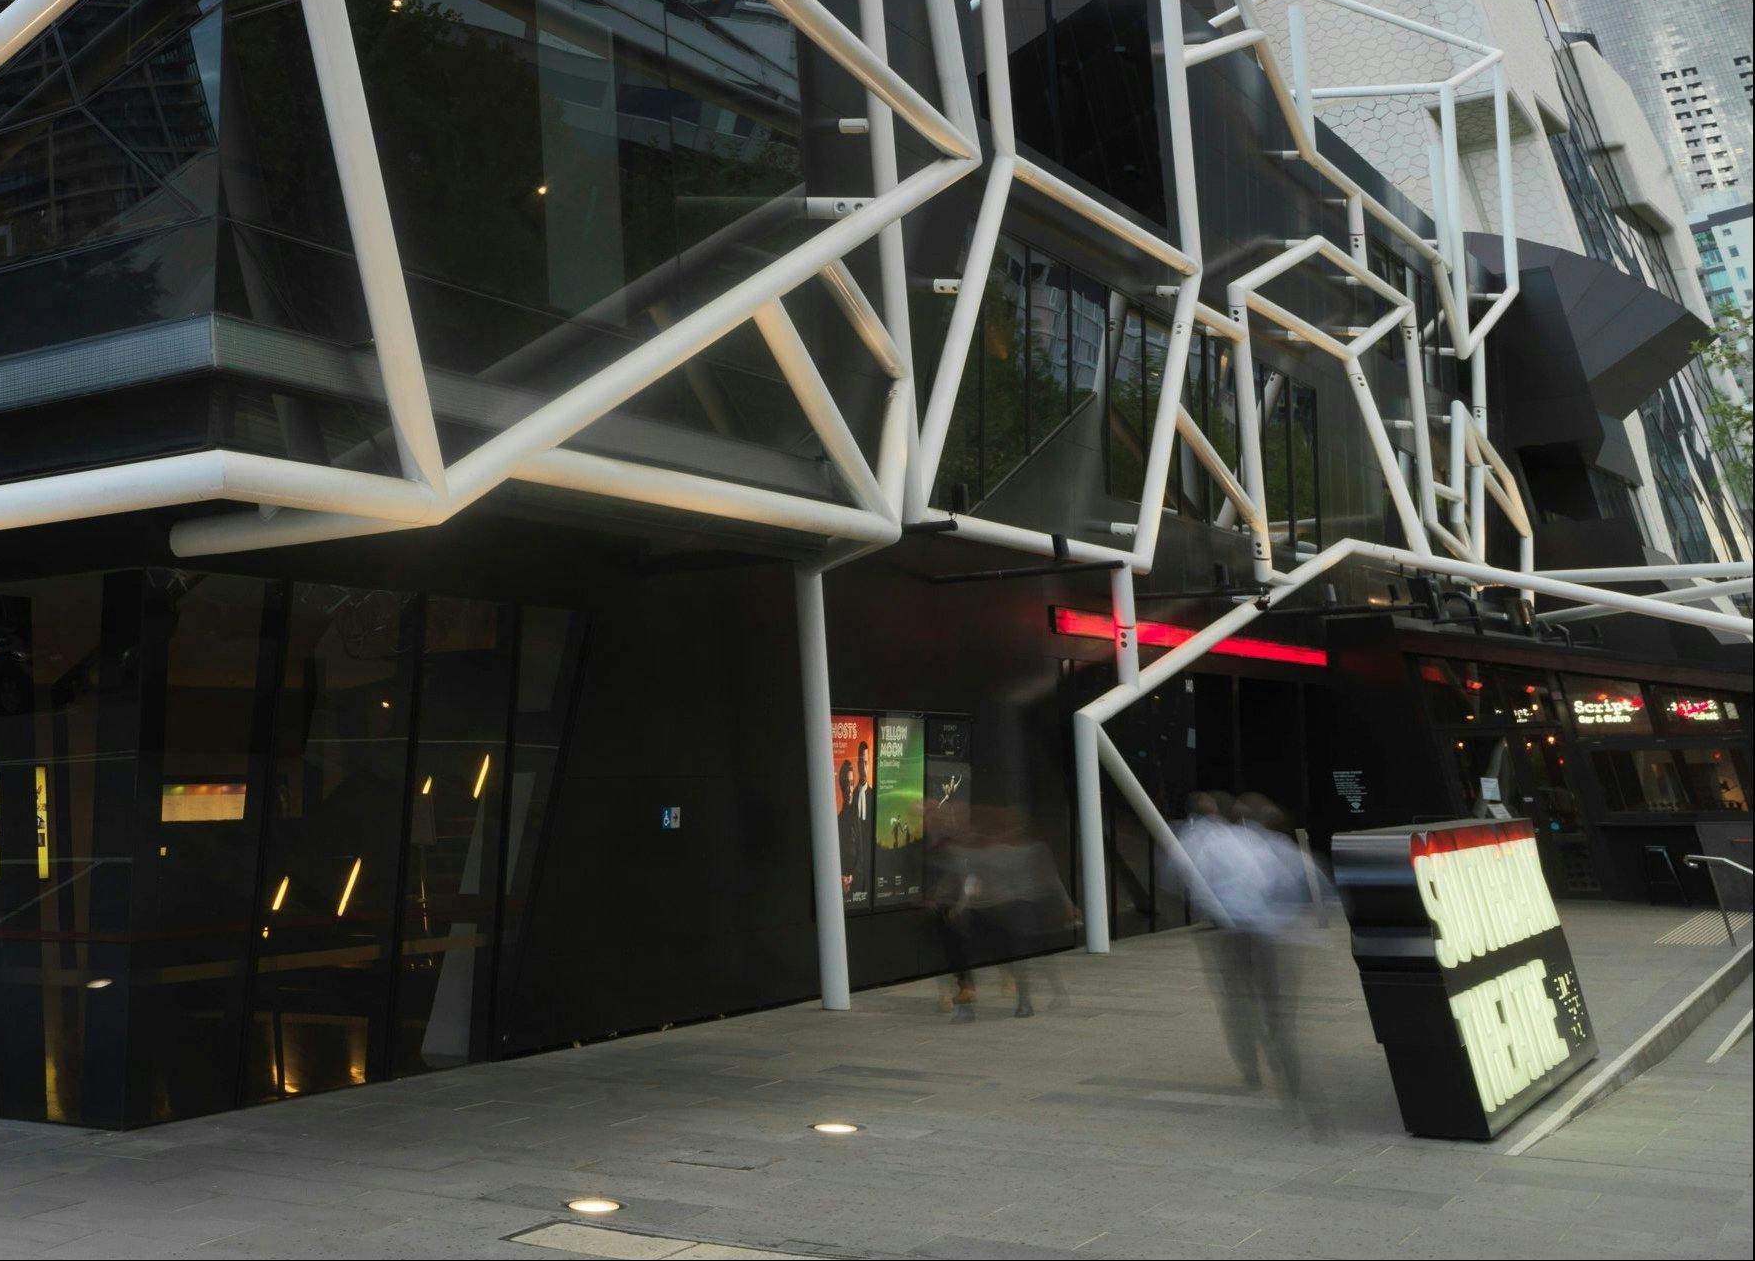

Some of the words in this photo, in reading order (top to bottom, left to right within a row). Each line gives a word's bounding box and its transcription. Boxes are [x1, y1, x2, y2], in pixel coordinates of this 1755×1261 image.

[831, 722, 858, 740] HOSTS
[880, 725, 908, 741] YELLOW
[880, 742, 903, 757] MOON
